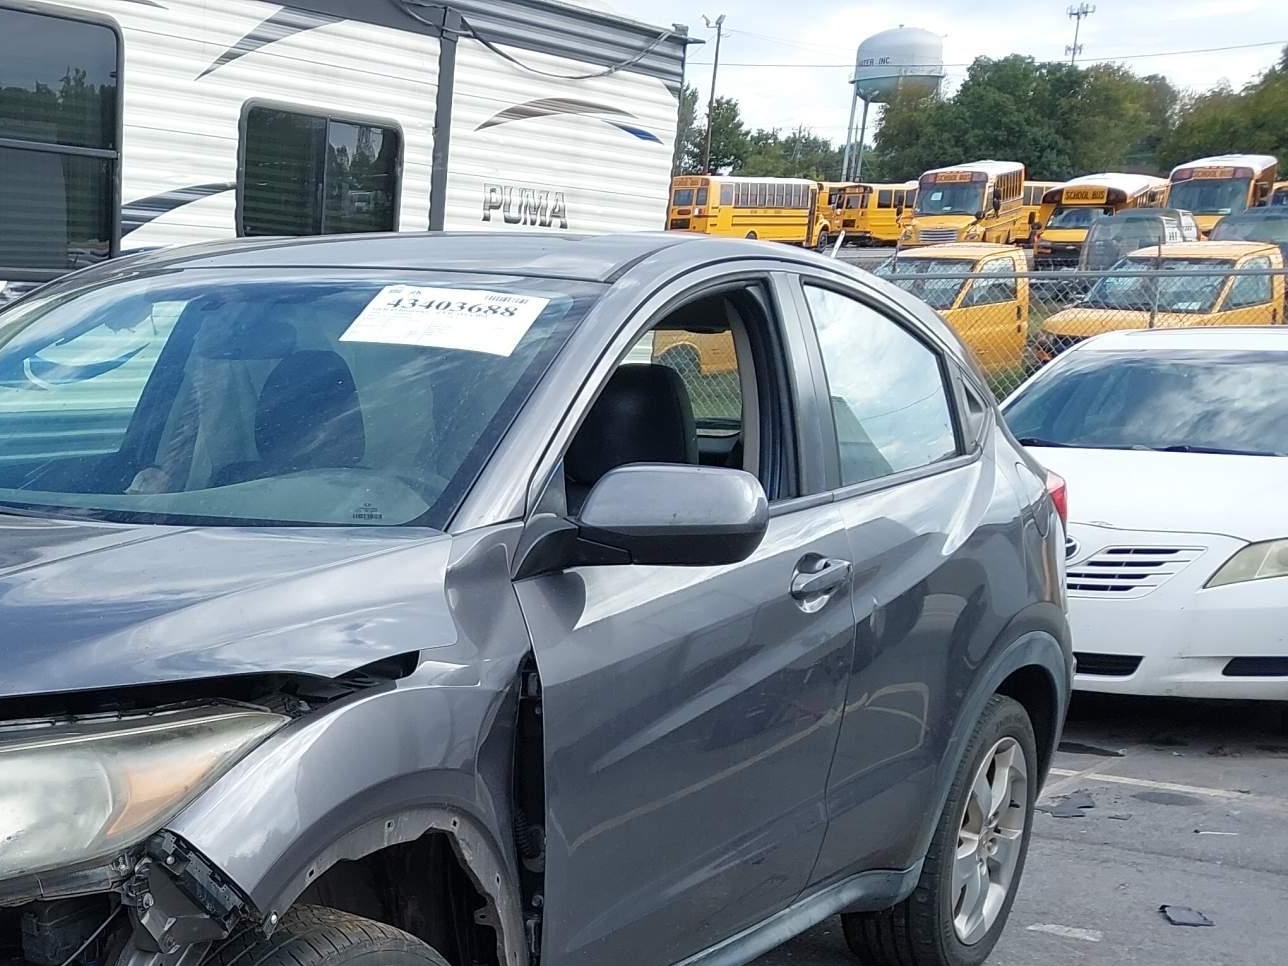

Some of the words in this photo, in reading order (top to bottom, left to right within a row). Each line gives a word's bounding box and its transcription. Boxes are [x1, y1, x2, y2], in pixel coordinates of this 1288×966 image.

[1065, 191, 1089, 200] SCHOOL
[1091, 190, 1105, 200] BUS
[482, 183, 568, 229] PUMA
[386, 297, 519, 318] 43403688
